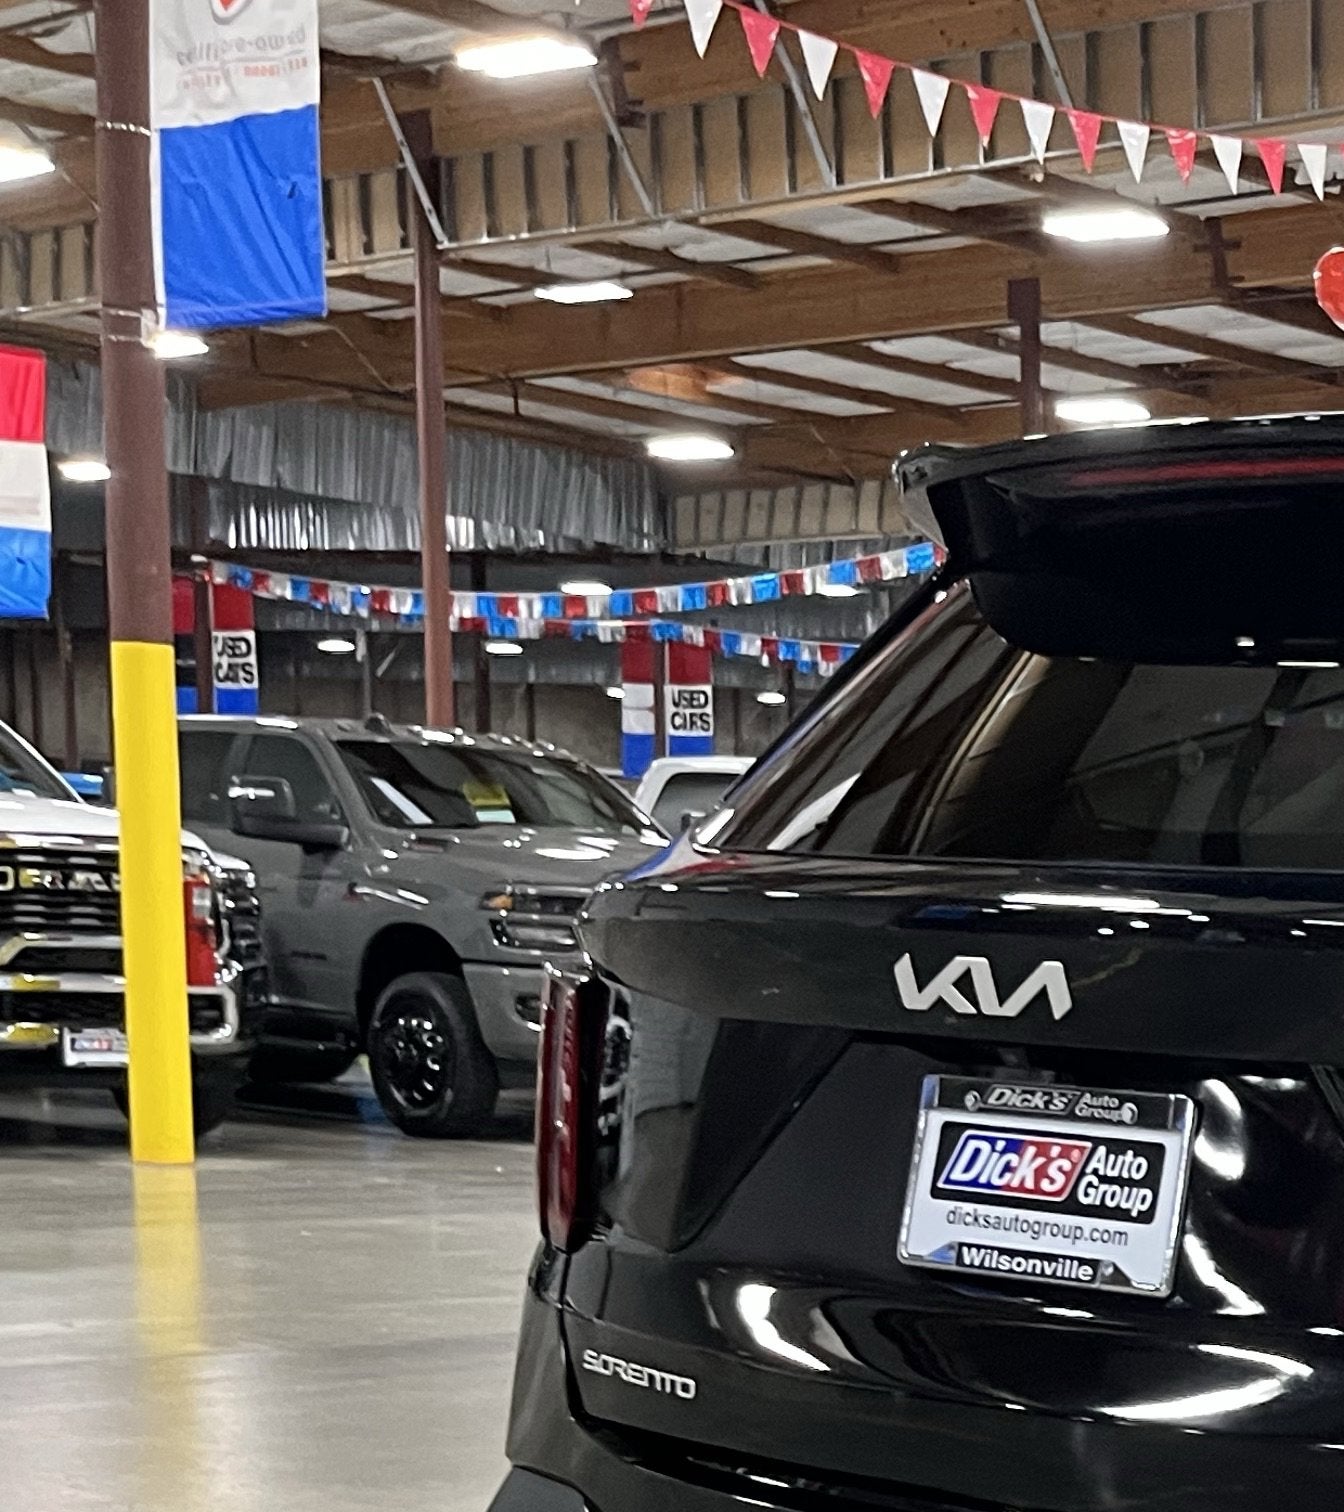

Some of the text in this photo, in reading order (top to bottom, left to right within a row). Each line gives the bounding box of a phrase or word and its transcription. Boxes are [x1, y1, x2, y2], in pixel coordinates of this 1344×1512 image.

[893, 951, 1073, 1021] KIA
[1078, 1092, 1120, 1109] Auto
[949, 1138, 1149, 1193] Dick's Auto
[1077, 1174, 1153, 1218] Group
[946, 1206, 1129, 1246] dicksautogroup.com
[961, 1246, 1095, 1281] Wilsonville
[582, 1348, 696, 1400] SORENTO
